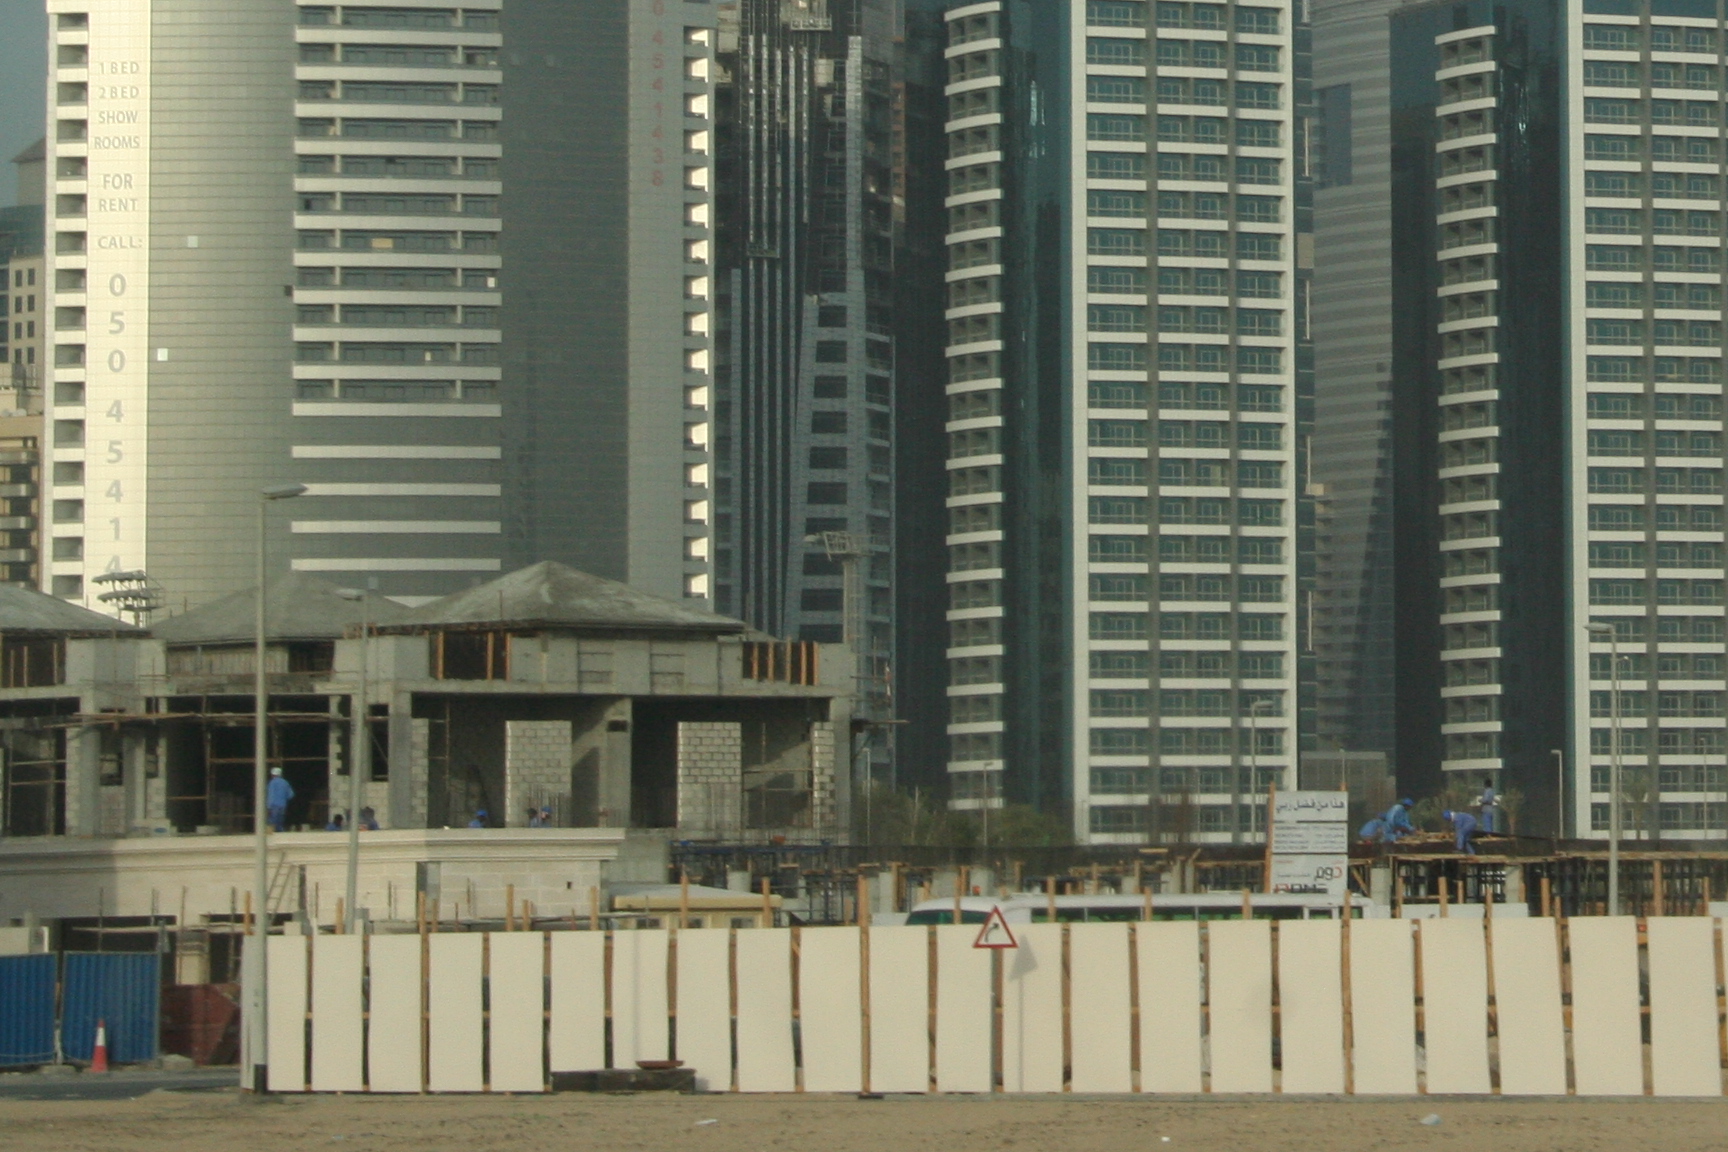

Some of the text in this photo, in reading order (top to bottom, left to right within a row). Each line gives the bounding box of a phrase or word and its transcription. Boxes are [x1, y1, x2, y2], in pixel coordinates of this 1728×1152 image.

[110, 61, 140, 75] BED
[110, 86, 140, 99] BED
[99, 111, 138, 124] SHOW
[94, 136, 140, 149] ROOMS
[103, 173, 133, 190] FOR
[99, 199, 138, 212] RENT
[97, 236, 143, 249] CALL:
